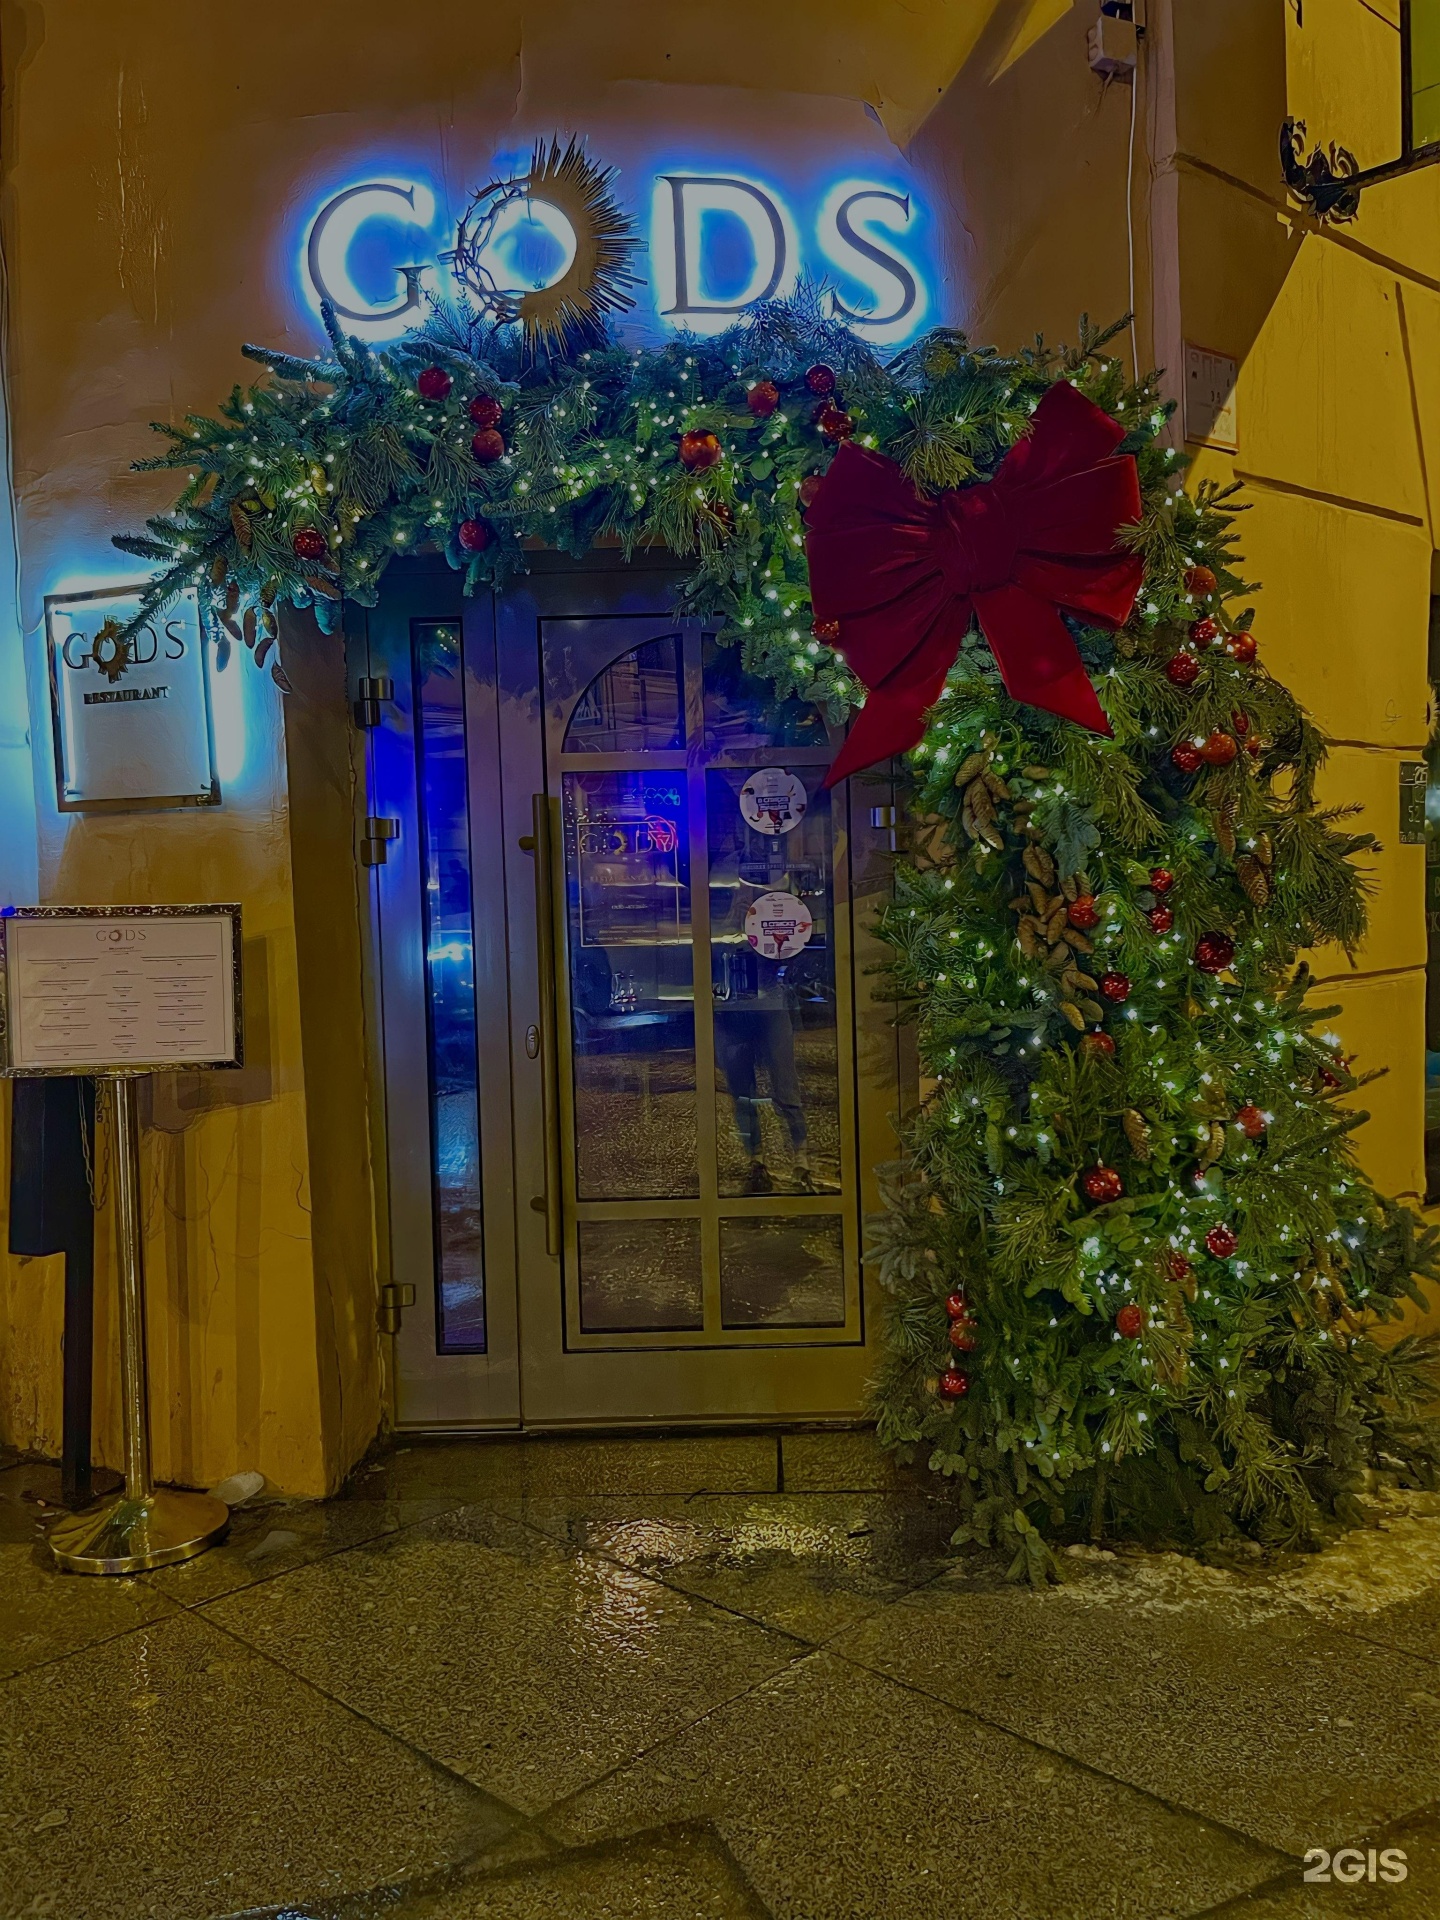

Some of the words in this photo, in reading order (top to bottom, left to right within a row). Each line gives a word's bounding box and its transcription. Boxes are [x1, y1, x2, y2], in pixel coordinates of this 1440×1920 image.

[305, 148, 920, 338] GODS
[62, 617, 185, 682] GODS
[83, 686, 170, 705] RESTAURANT
[95, 928, 147, 943] GODS
